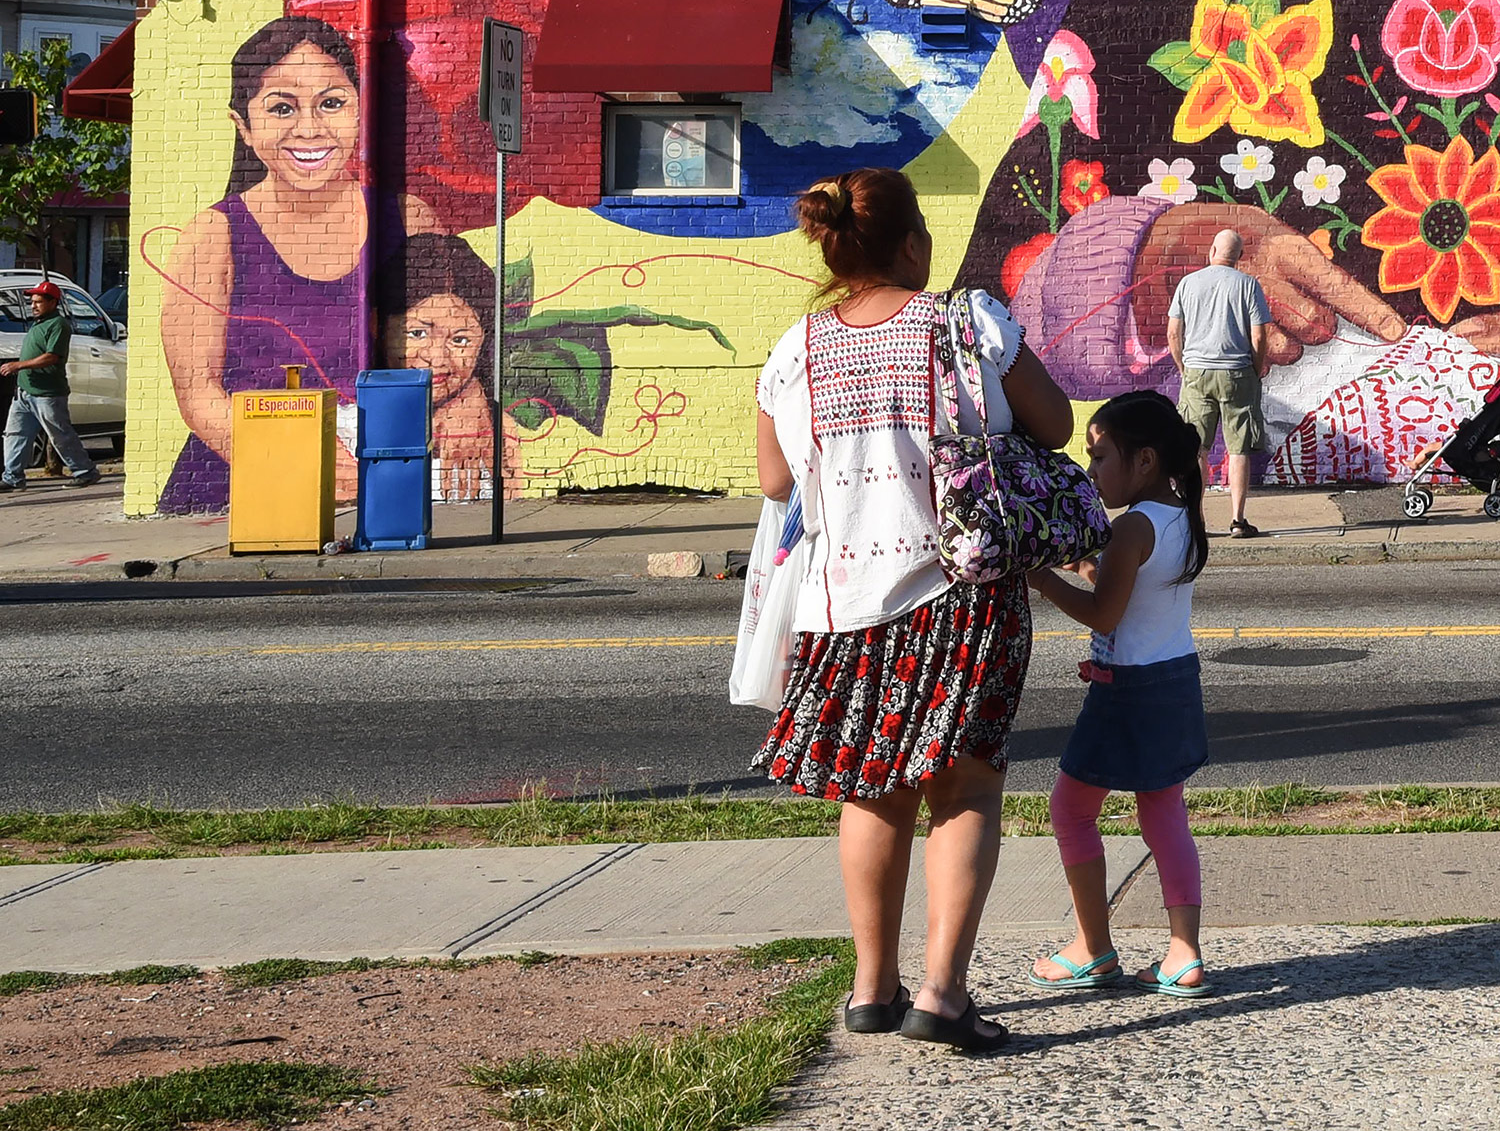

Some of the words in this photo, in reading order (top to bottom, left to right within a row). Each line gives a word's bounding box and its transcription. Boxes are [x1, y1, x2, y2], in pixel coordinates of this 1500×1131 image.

[500, 38, 514, 63] NO
[497, 70, 516, 91] TURN
[500, 97, 512, 117] ON
[498, 123, 513, 143] RED
[246, 398, 255, 411] El
[258, 397, 314, 414] Especialito
